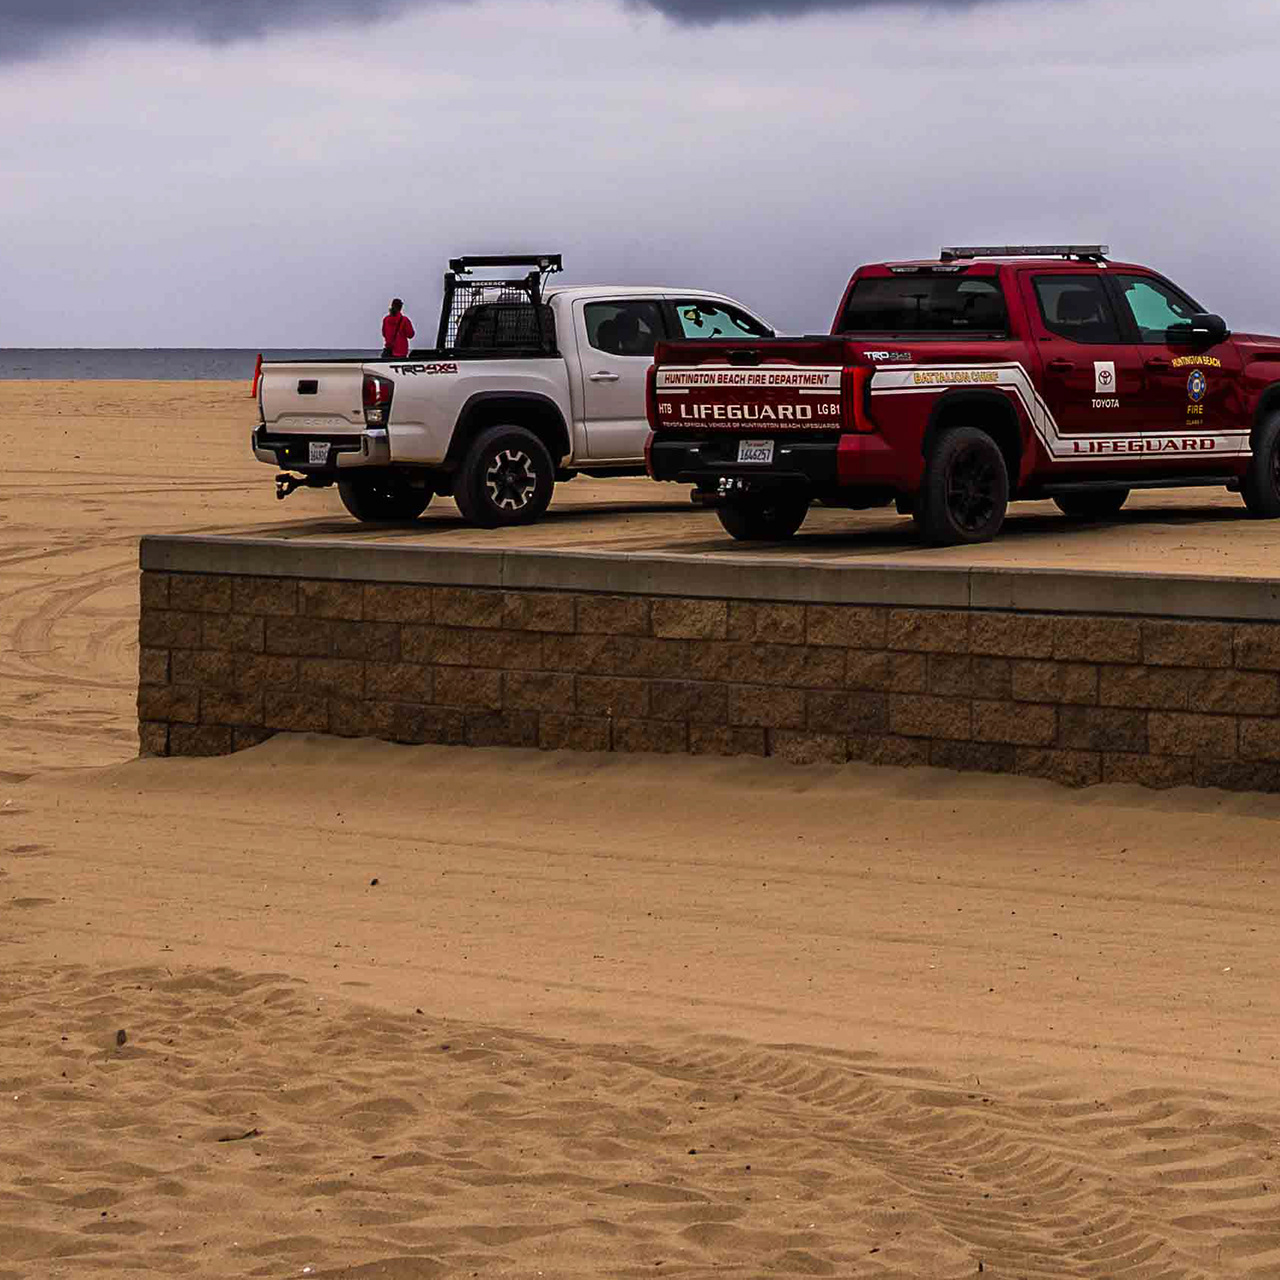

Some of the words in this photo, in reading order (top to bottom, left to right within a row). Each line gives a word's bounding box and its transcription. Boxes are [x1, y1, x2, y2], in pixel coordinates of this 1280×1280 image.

[664, 373, 716, 384] HUNTINGTON
[717, 373, 746, 385] BEACH
[747, 374, 767, 385] FIRE
[768, 374, 830, 385] DEPARTMENT
[658, 403, 673, 415] HTB
[817, 403, 829, 415] LG
[1091, 398, 1120, 408] TOYOTA
[680, 403, 812, 419] LIFEGUARD
[1187, 404, 1204, 415] FIRE
[1073, 438, 1216, 453] LIFEGUARD
